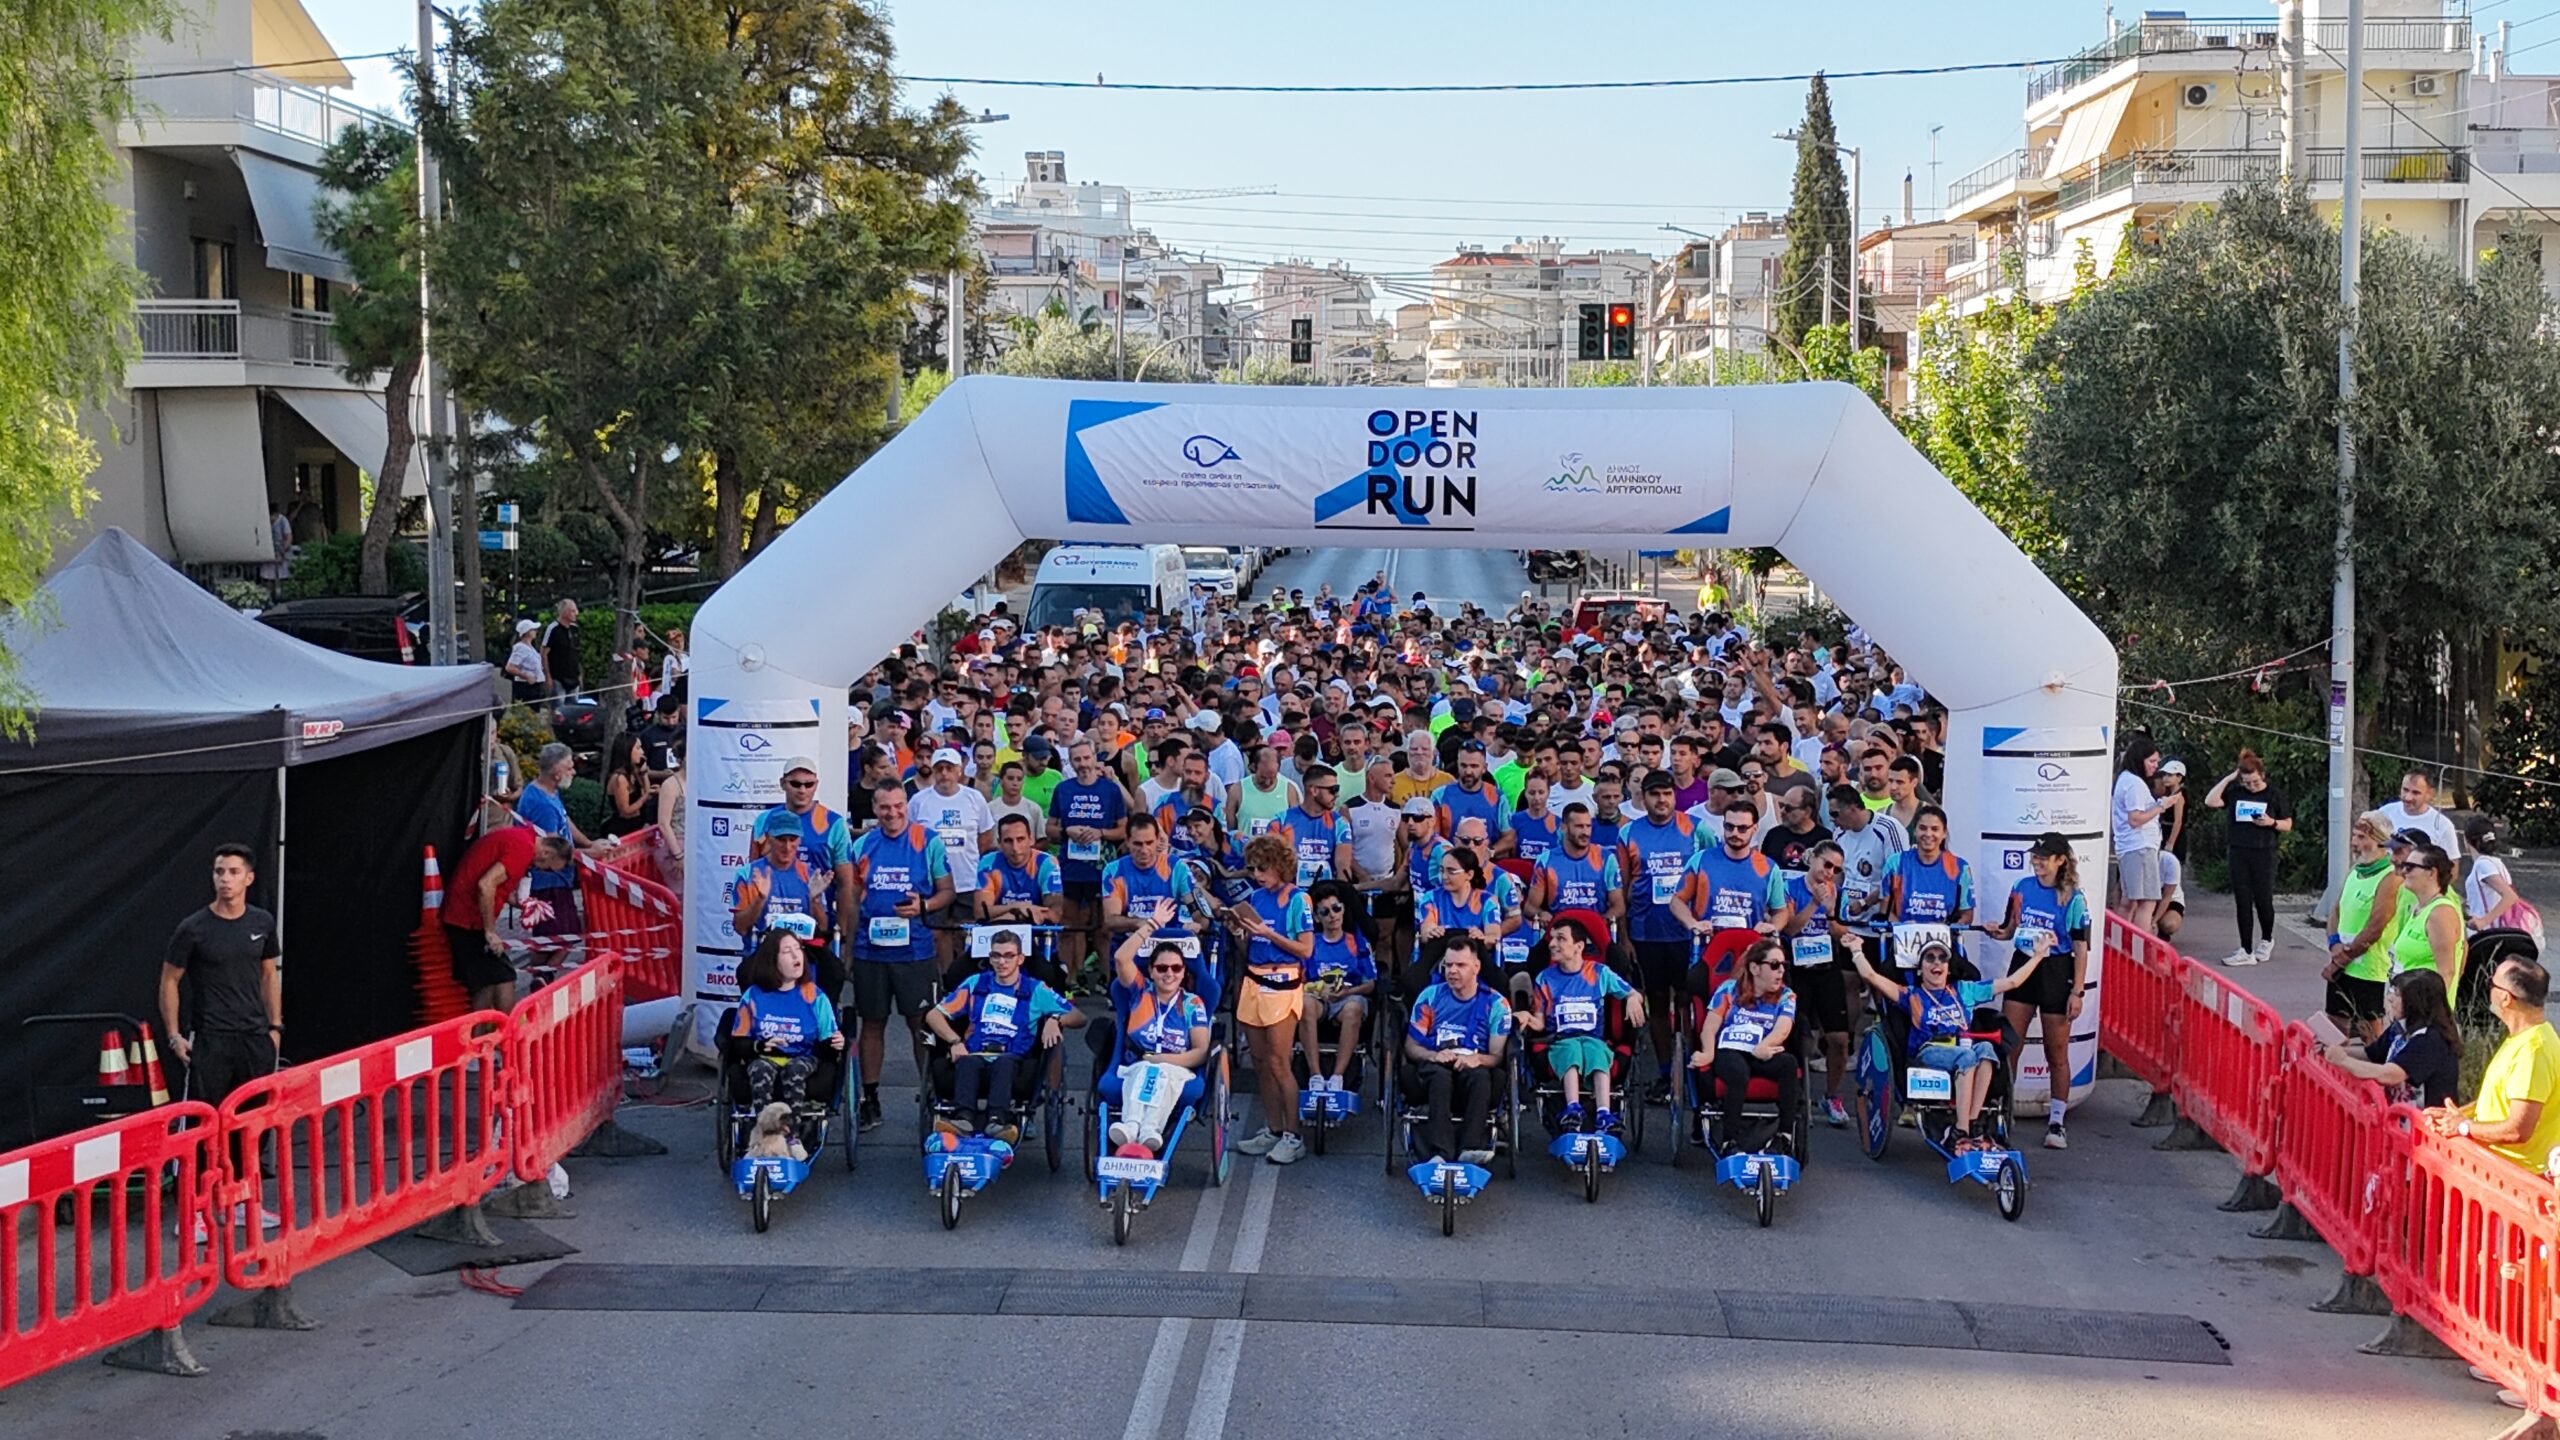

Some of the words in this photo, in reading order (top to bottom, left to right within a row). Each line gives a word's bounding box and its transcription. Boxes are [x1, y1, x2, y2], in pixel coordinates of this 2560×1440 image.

[1367, 410, 1478, 439] OPEN
[1368, 440, 1476, 469] DOOR
[1607, 464, 1640, 473] ΔΗΜΟΣ
[1606, 474, 1662, 484] ΕΛΛΗΝΙΚΟΥ
[1367, 474, 1476, 517] RUN
[1606, 485, 1682, 495] ΑΡΓΥΡΟΥΠΟΛΗΣ
[2024, 1066, 2044, 1075] my
[1103, 1162, 1157, 1174] ΔΗΜΗΤΡΑ
